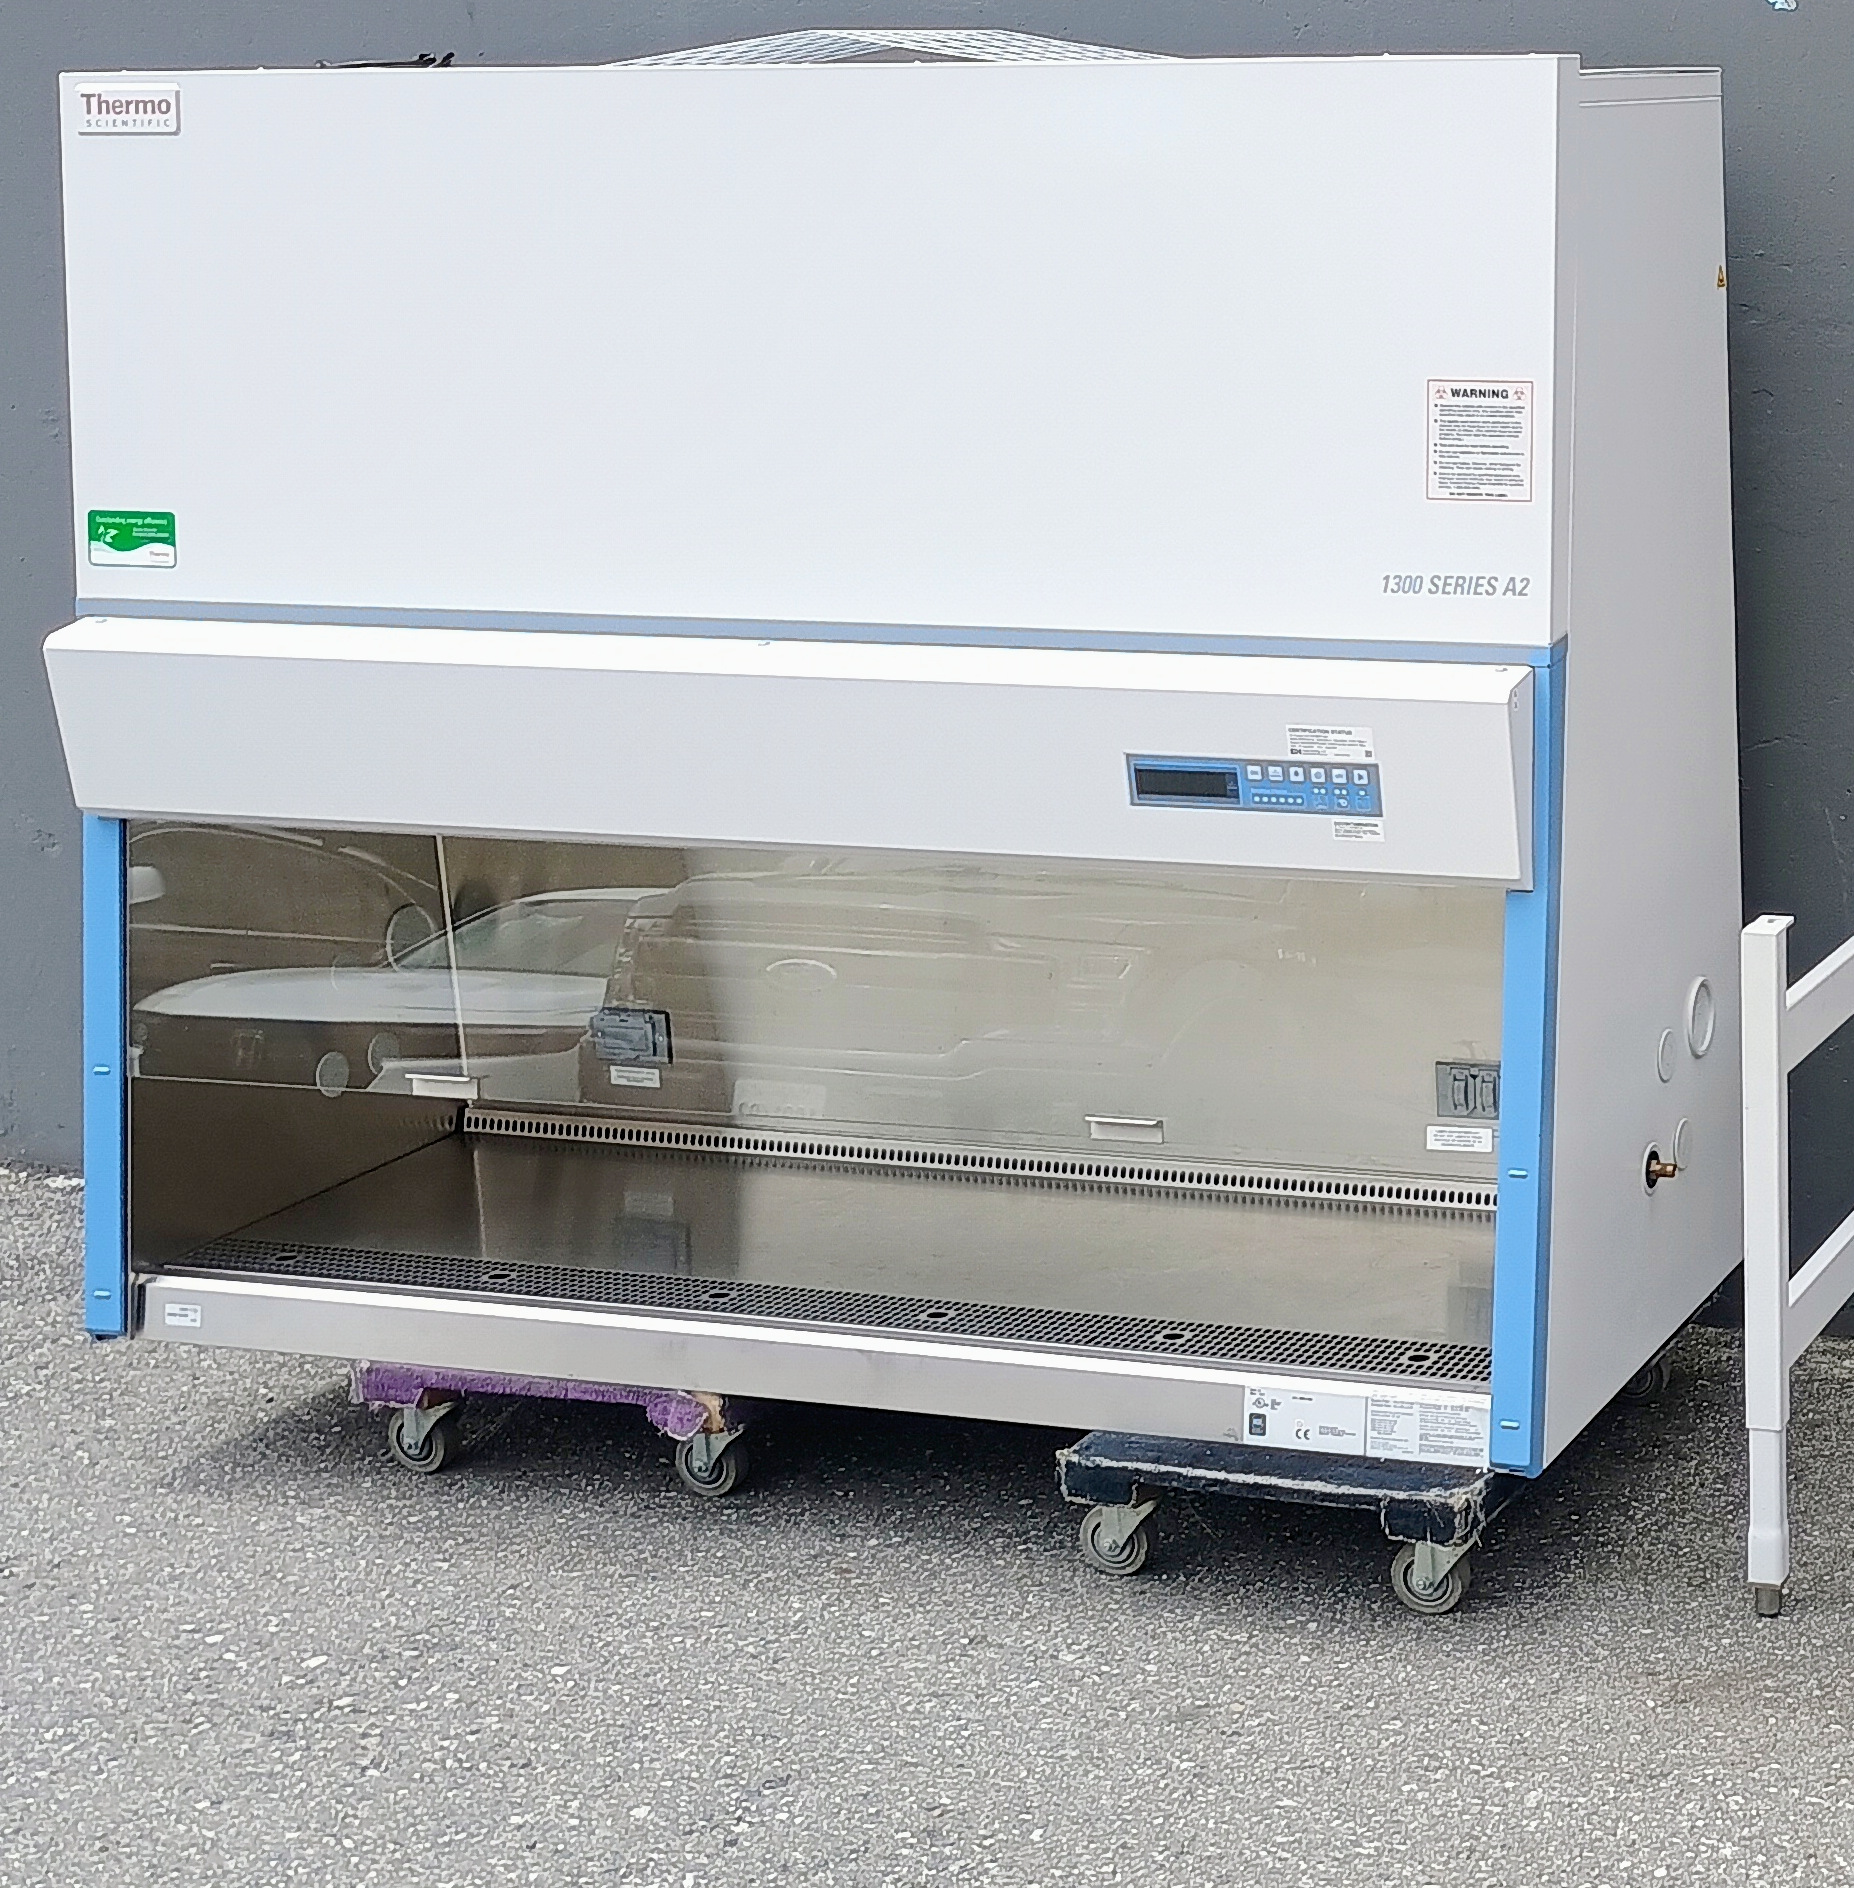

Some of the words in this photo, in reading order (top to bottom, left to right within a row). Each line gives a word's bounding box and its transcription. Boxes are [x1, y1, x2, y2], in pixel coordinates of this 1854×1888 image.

[80, 93, 172, 115] Thermo
[86, 118, 170, 128] SCIENTIFIC
[1450, 387, 1509, 400] WARNING
[1382, 574, 1424, 595] 1300
[1427, 574, 1499, 597] SERIES
[1502, 576, 1531, 597] A2
